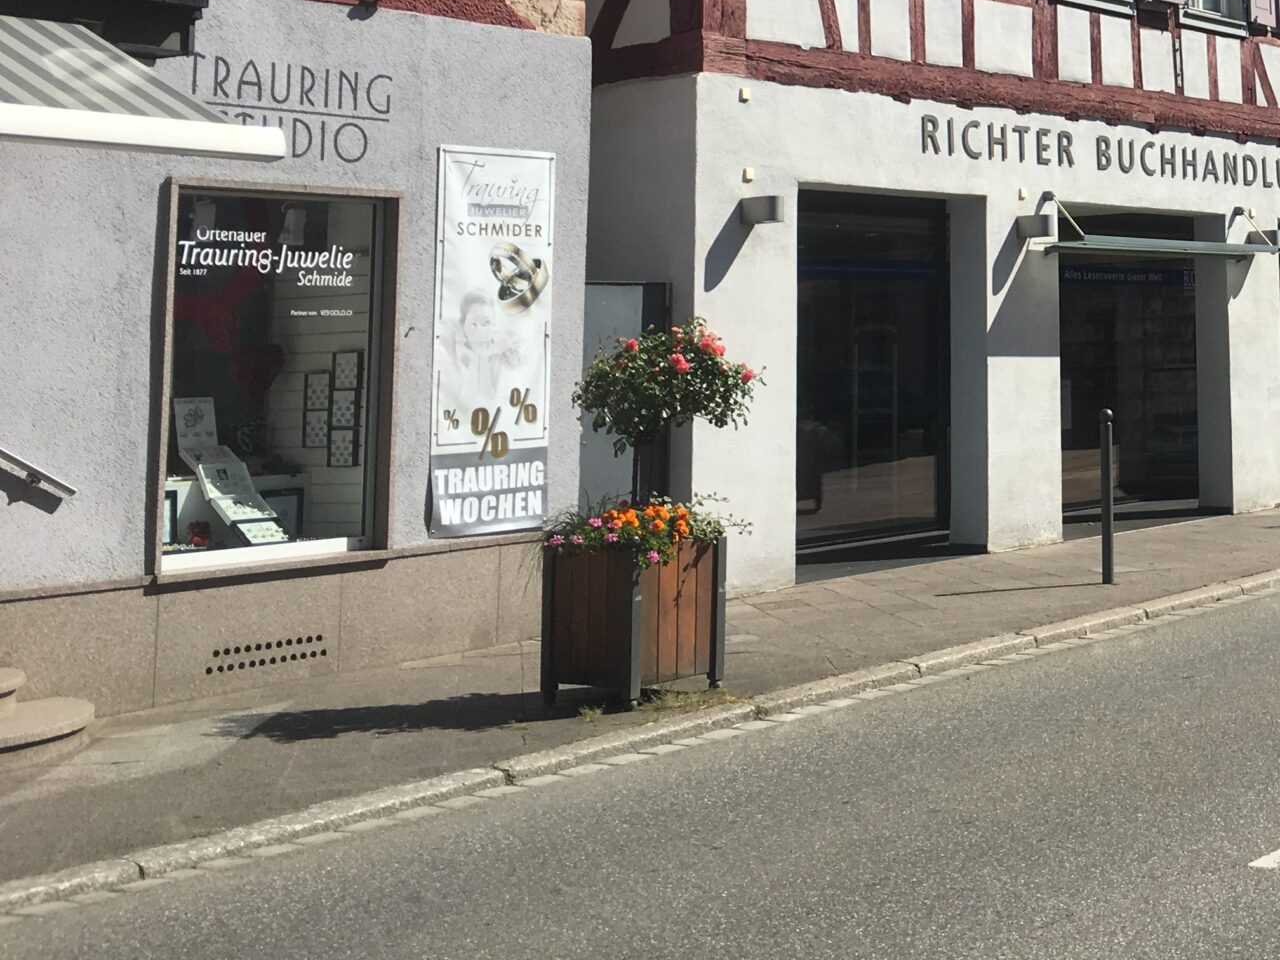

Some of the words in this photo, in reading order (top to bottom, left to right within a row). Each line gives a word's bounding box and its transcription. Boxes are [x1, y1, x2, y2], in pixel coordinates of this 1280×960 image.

[187, 52, 393, 115] TRAURING
[921, 114, 1075, 168] RICHTER
[451, 160, 541, 226] Trauring
[470, 206, 528, 217] JUWELIER
[197, 226, 267, 242] Ortenauer
[457, 221, 543, 238] SCHMIDER
[178, 240, 354, 274] Trauring-Juwelie
[193, 267, 208, 276] 1877
[297, 271, 353, 287] Schmide
[434, 460, 545, 495] TRAURING
[438, 489, 543, 526] WOCHEN
